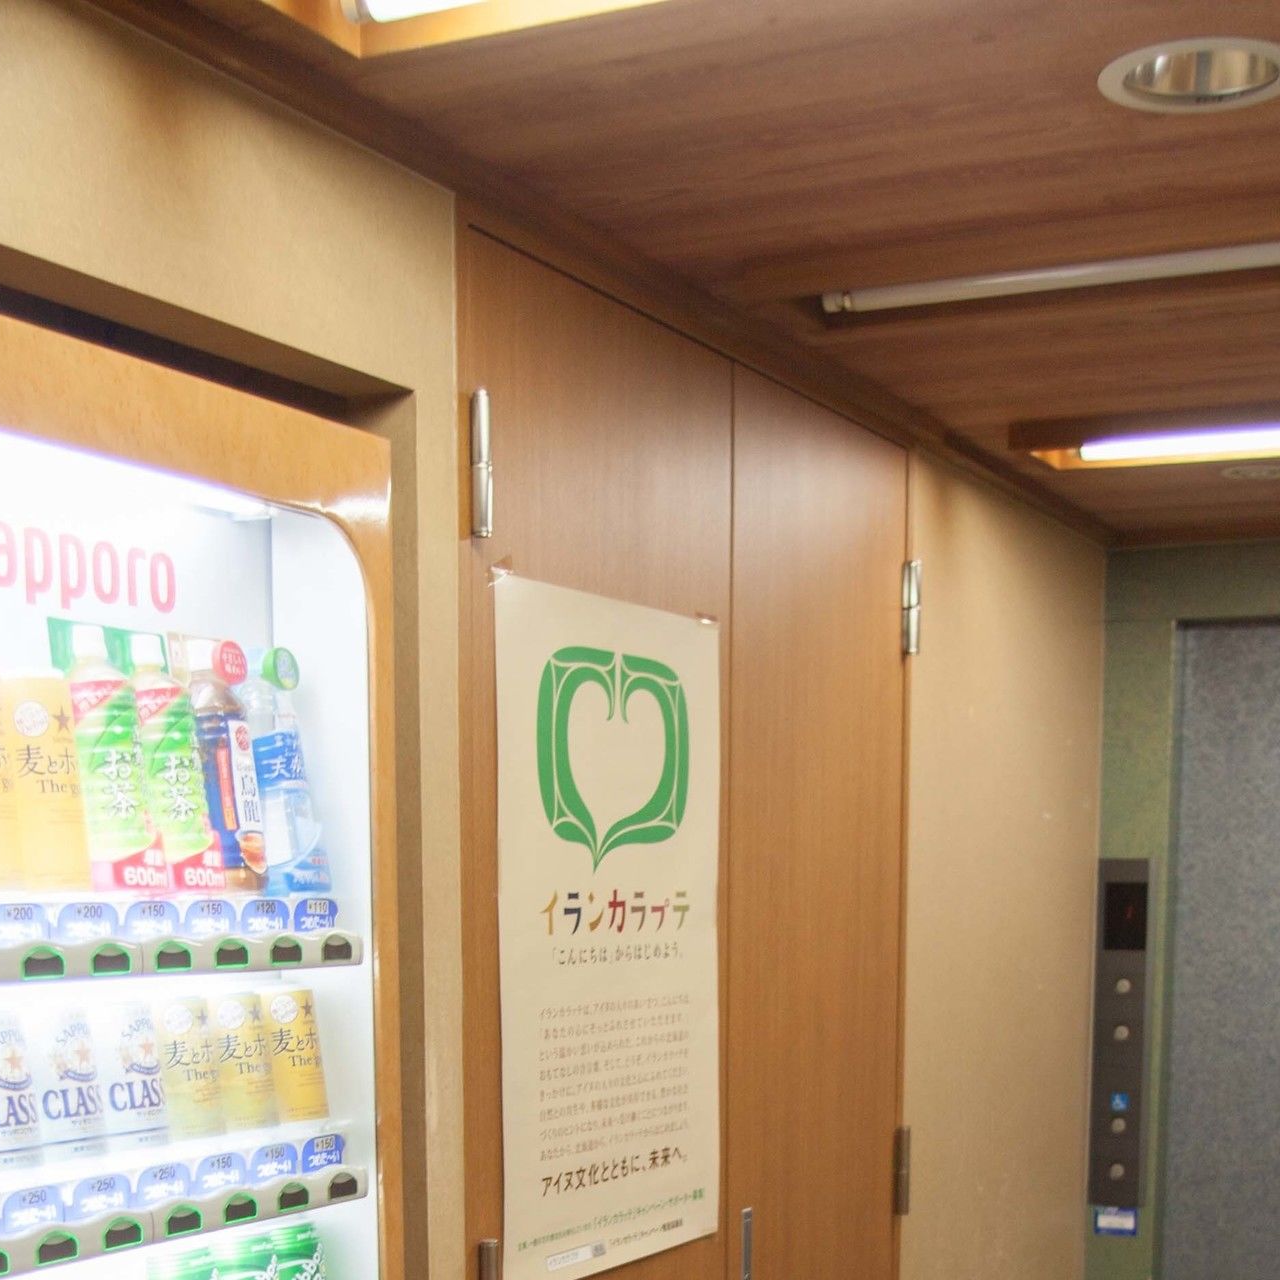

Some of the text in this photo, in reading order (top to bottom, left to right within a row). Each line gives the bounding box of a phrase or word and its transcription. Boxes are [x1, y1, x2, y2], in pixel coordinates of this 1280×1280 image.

[97, 750, 138, 818] お茶
[157, 753, 200, 822] お茶
[6, 905, 33, 921] ¥200
[76, 904, 103, 919] ¥200
[141, 903, 166, 917] ¥150
[200, 902, 223, 916] ¥150
[255, 900, 277, 914] ¥120
[308, 900, 328, 914] ¥110
[316, 1137, 335, 1150] ¥150
[265, 1145, 285, 1159] ¥150
[211, 1156, 233, 1169] ¥150
[152, 1165, 176, 1181] ¥250
[90, 1177, 116, 1192] ¥250
[22, 1190, 47, 1205] ¥250
